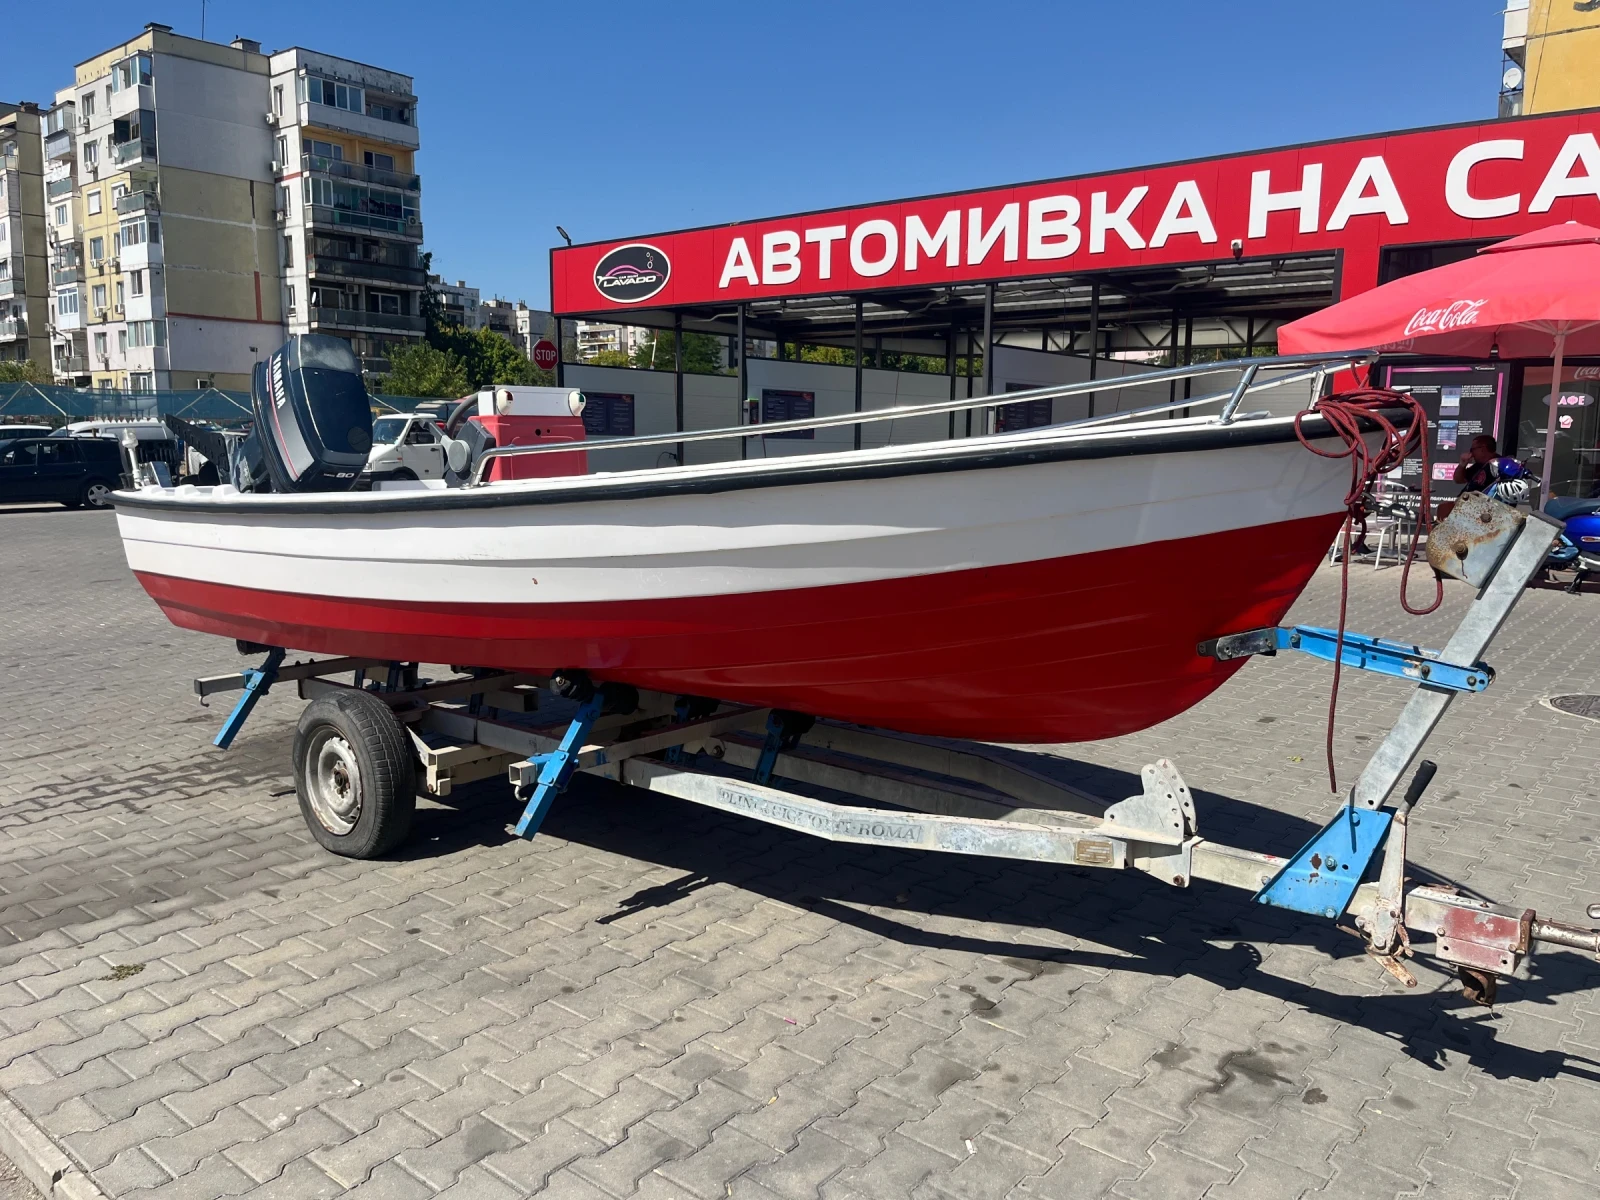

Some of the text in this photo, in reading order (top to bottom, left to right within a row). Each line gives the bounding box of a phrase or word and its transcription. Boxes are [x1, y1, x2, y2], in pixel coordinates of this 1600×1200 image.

[717, 132, 1600, 289] АВТОМИВКА НА СА
[603, 275, 656, 287] LAVADO
[1403, 299, 1488, 336] Coca-Cola
[535, 349, 556, 361] STOP
[272, 353, 286, 409] YAMAHA
[1556, 395, 1586, 405] АФЕ
